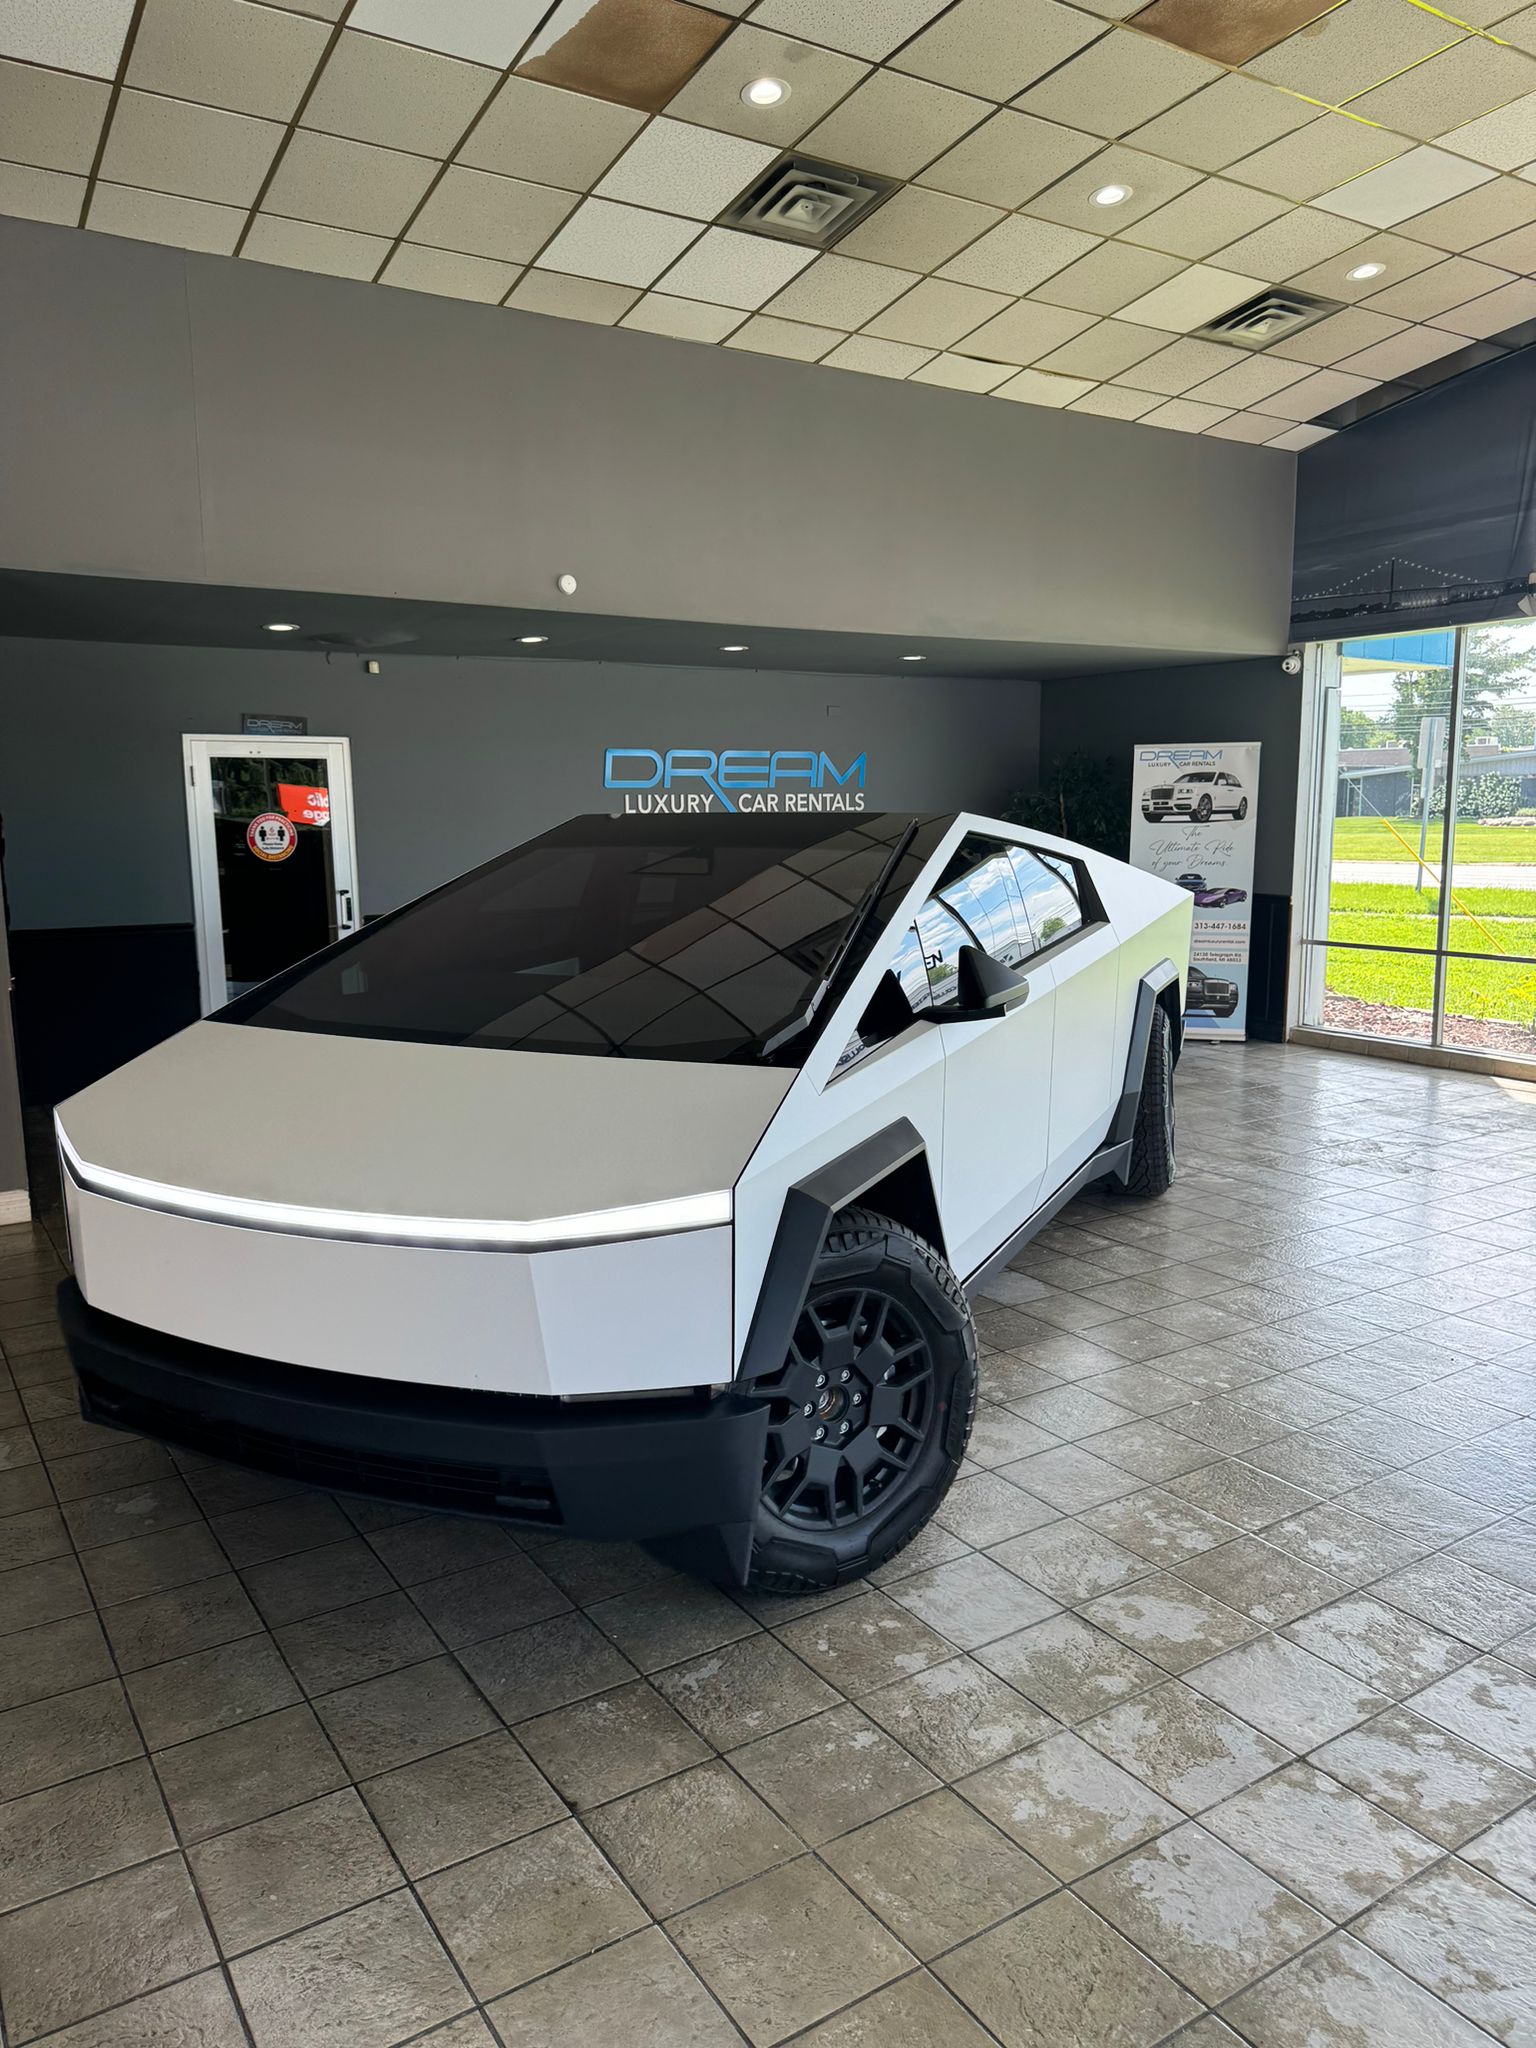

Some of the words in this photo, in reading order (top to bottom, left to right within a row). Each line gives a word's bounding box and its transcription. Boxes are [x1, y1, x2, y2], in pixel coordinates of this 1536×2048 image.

[247, 719, 304, 734] DREAM
[1140, 750, 1223, 769] DREAM
[604, 748, 867, 812] DREAM
[624, 794, 715, 814] LUXURY
[738, 794, 779, 812] CAR
[785, 792, 865, 812] RENTALS
[1182, 825, 1210, 840] The
[1149, 840, 1201, 855] Ultimate
[1205, 840, 1234, 856] Ride
[1152, 857, 1162, 870] of
[1160, 861, 1182, 872] your
[1194, 922, 1246, 930] 313-447-1684
